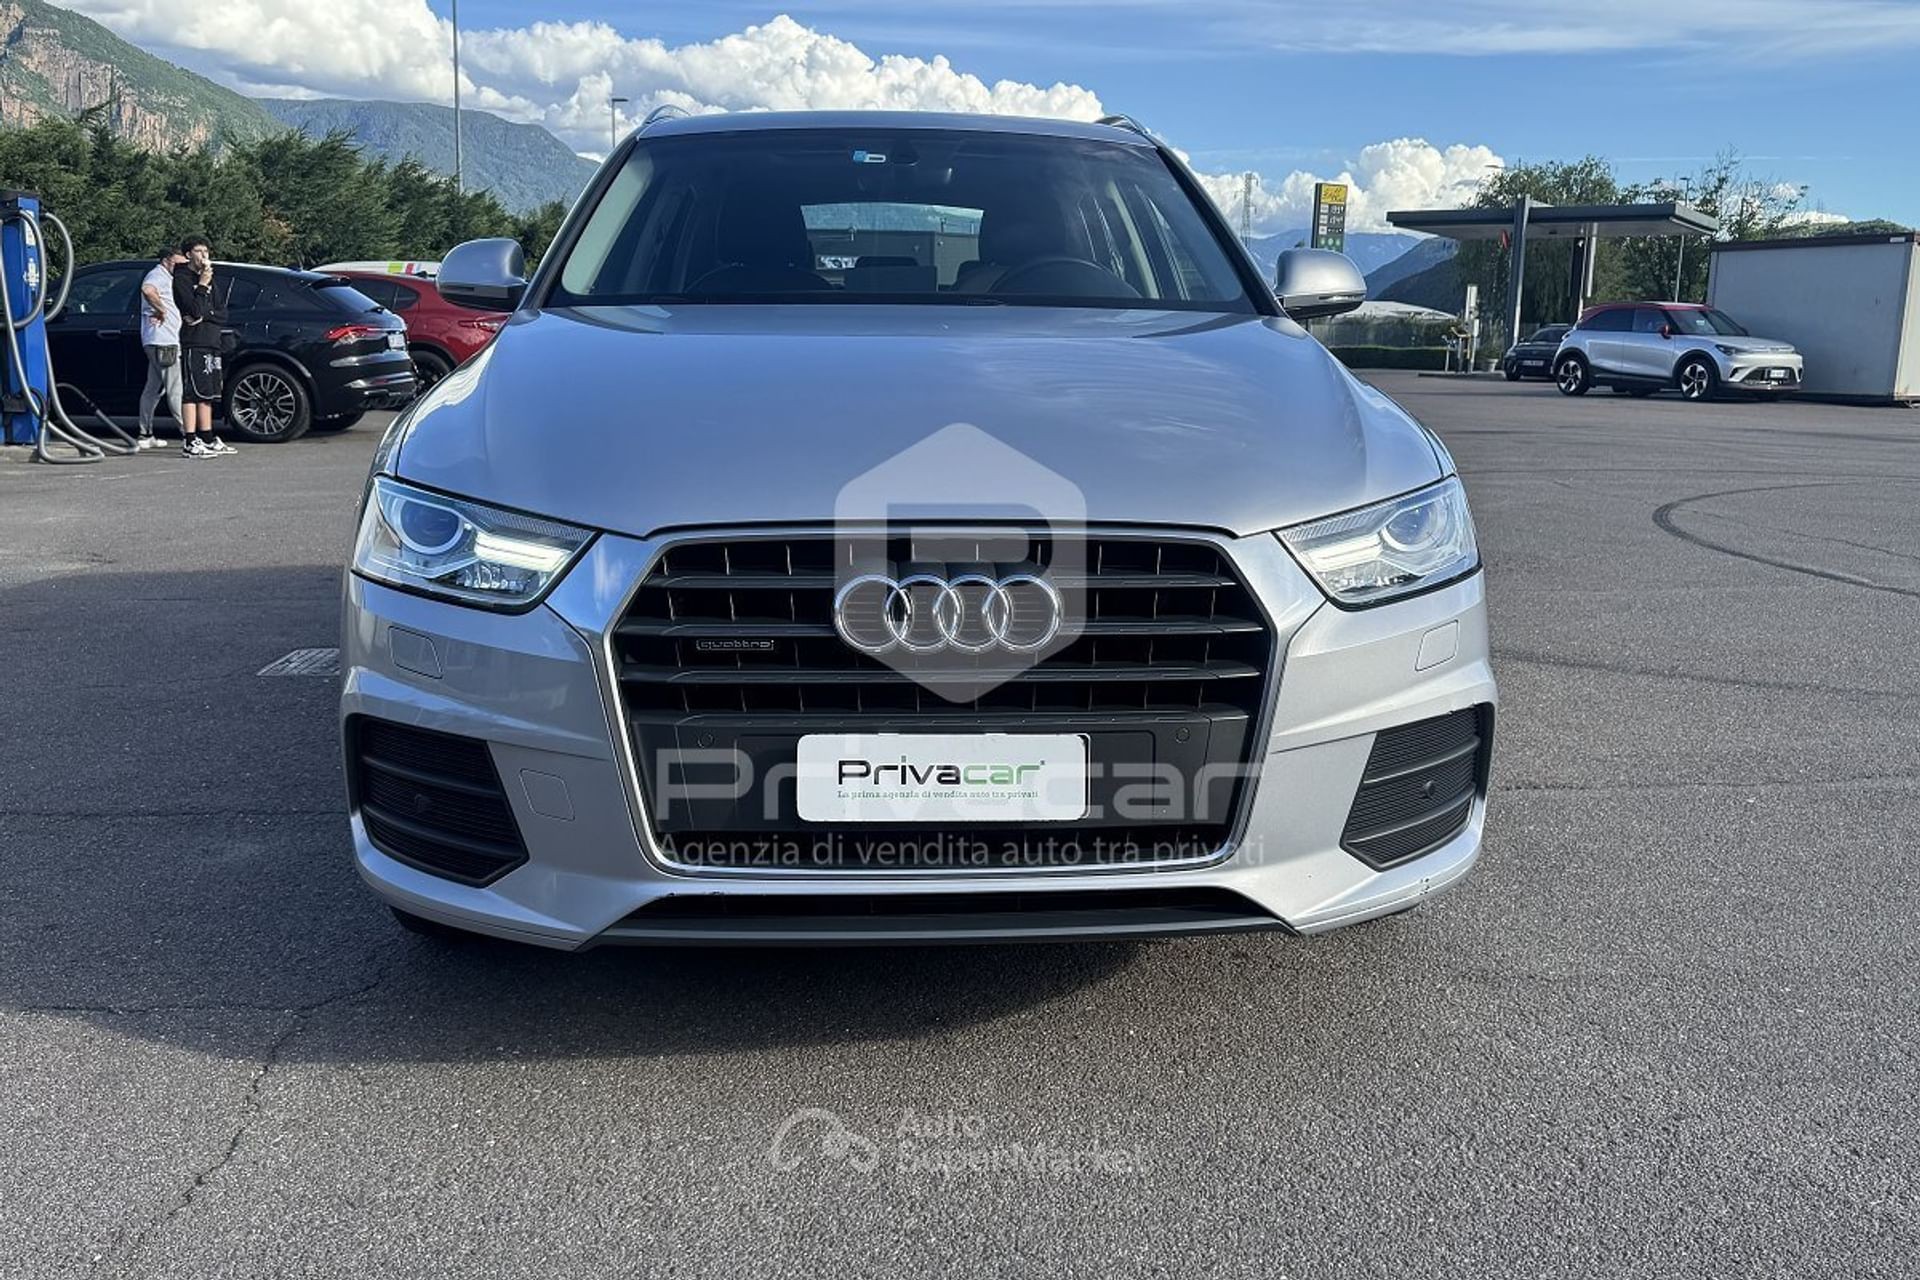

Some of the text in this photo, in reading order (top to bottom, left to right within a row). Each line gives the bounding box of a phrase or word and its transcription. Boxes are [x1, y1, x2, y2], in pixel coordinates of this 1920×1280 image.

[697, 639, 773, 651] quattro
[838, 755, 1041, 785] Privacar
[837, 790, 1038, 800] La prima agenzia di vendita auto tra privati
